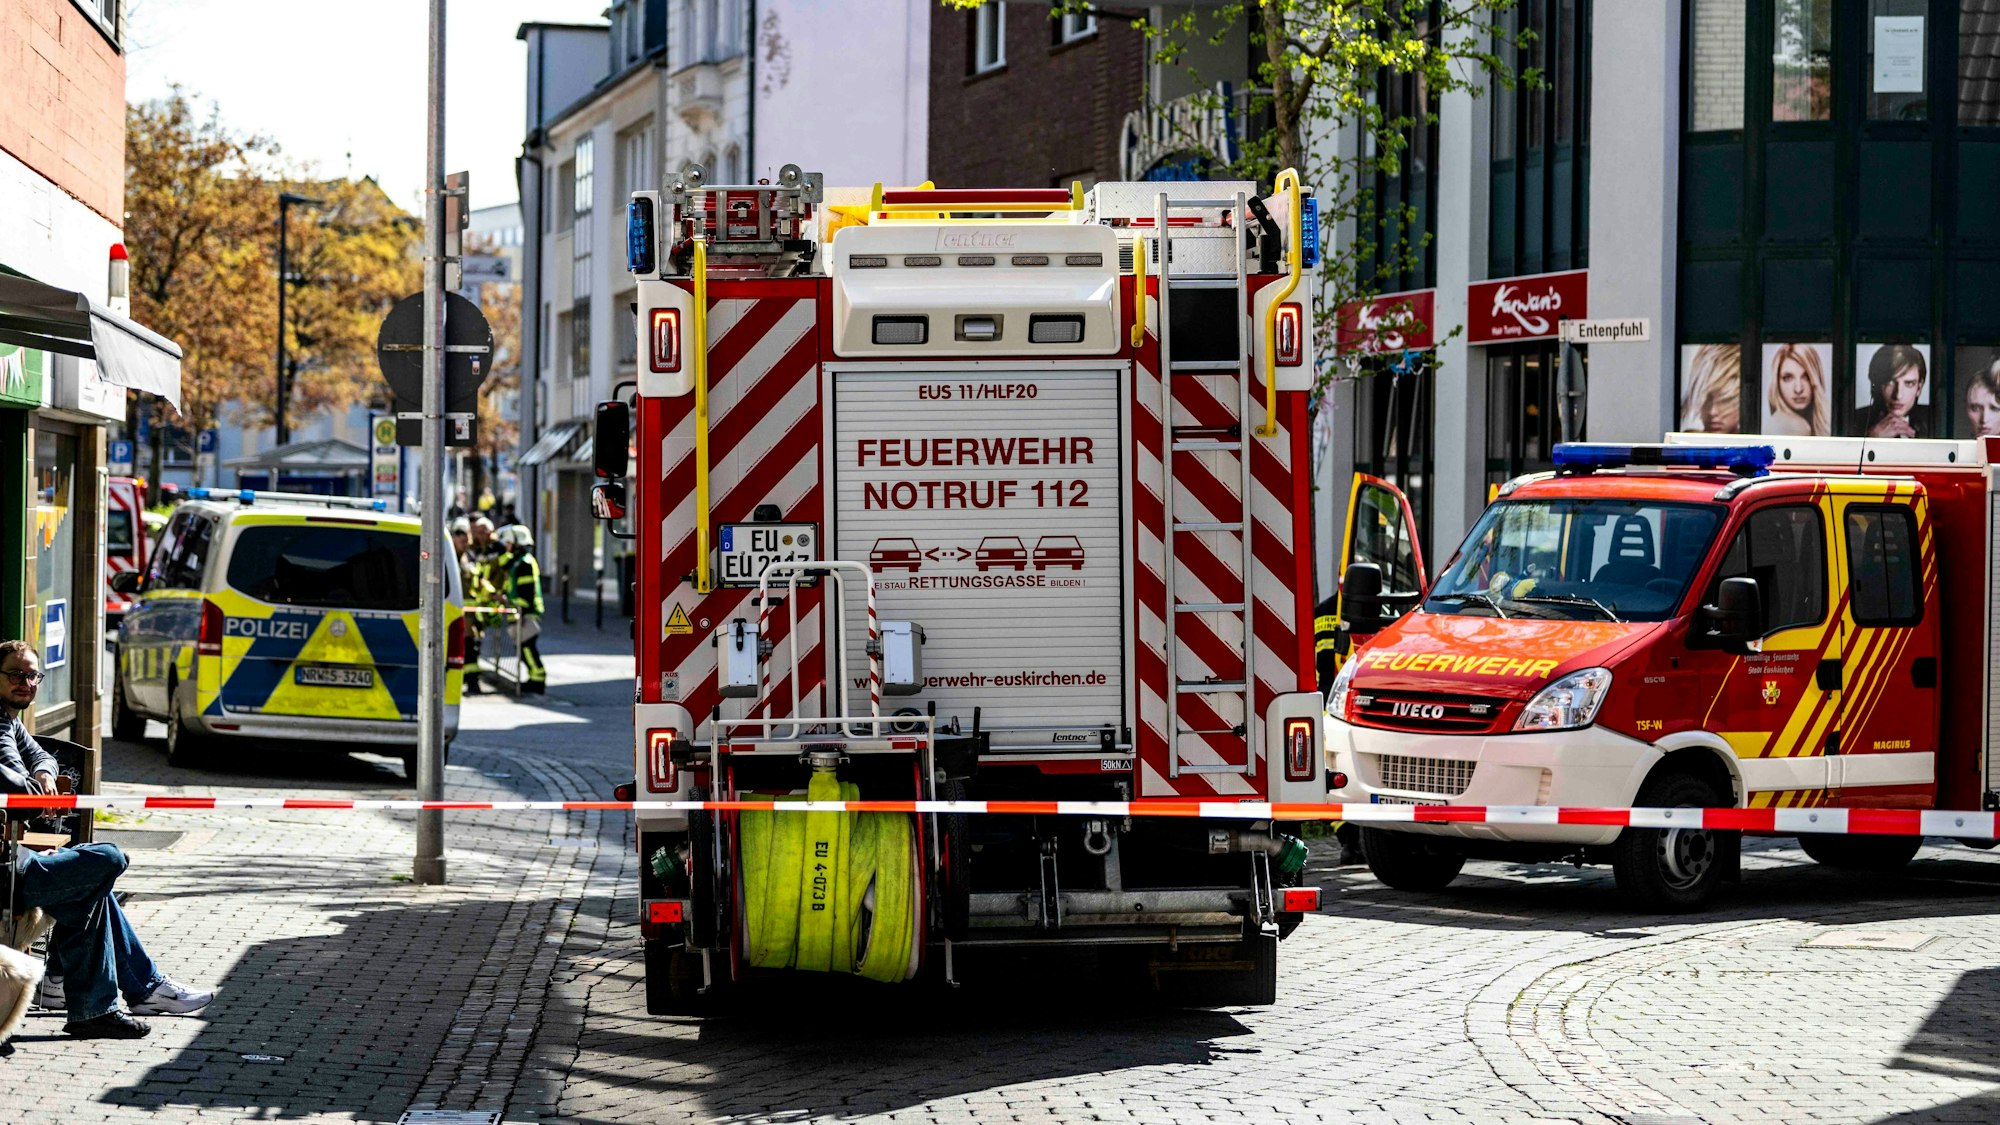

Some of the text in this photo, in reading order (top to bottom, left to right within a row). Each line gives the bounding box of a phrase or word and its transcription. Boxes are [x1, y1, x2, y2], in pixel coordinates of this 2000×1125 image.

[1579, 323, 1643, 338] Entenpfuhl
[919, 384, 1038, 400] EUS 11/HLF20
[115, 445, 128, 463] P
[857, 437, 1094, 467] FEUERWEHR
[864, 480, 1089, 510] NOTRUF 112
[751, 530, 778, 552] EU
[726, 555, 752, 577] EU
[909, 575, 1046, 589] RETTUNGSGASSE
[1050, 579, 1081, 587] BILDEN
[225, 618, 309, 639] POLIZEI
[1356, 651, 1559, 679] FEUERWEHR
[1392, 702, 1444, 719] IVECO
[1636, 720, 1662, 731] TSF-W
[1873, 740, 1911, 750] MAGIRUS
[1103, 759, 1122, 770] 50kN
[814, 841, 828, 857] EU
[812, 862, 828, 900] 4-073
